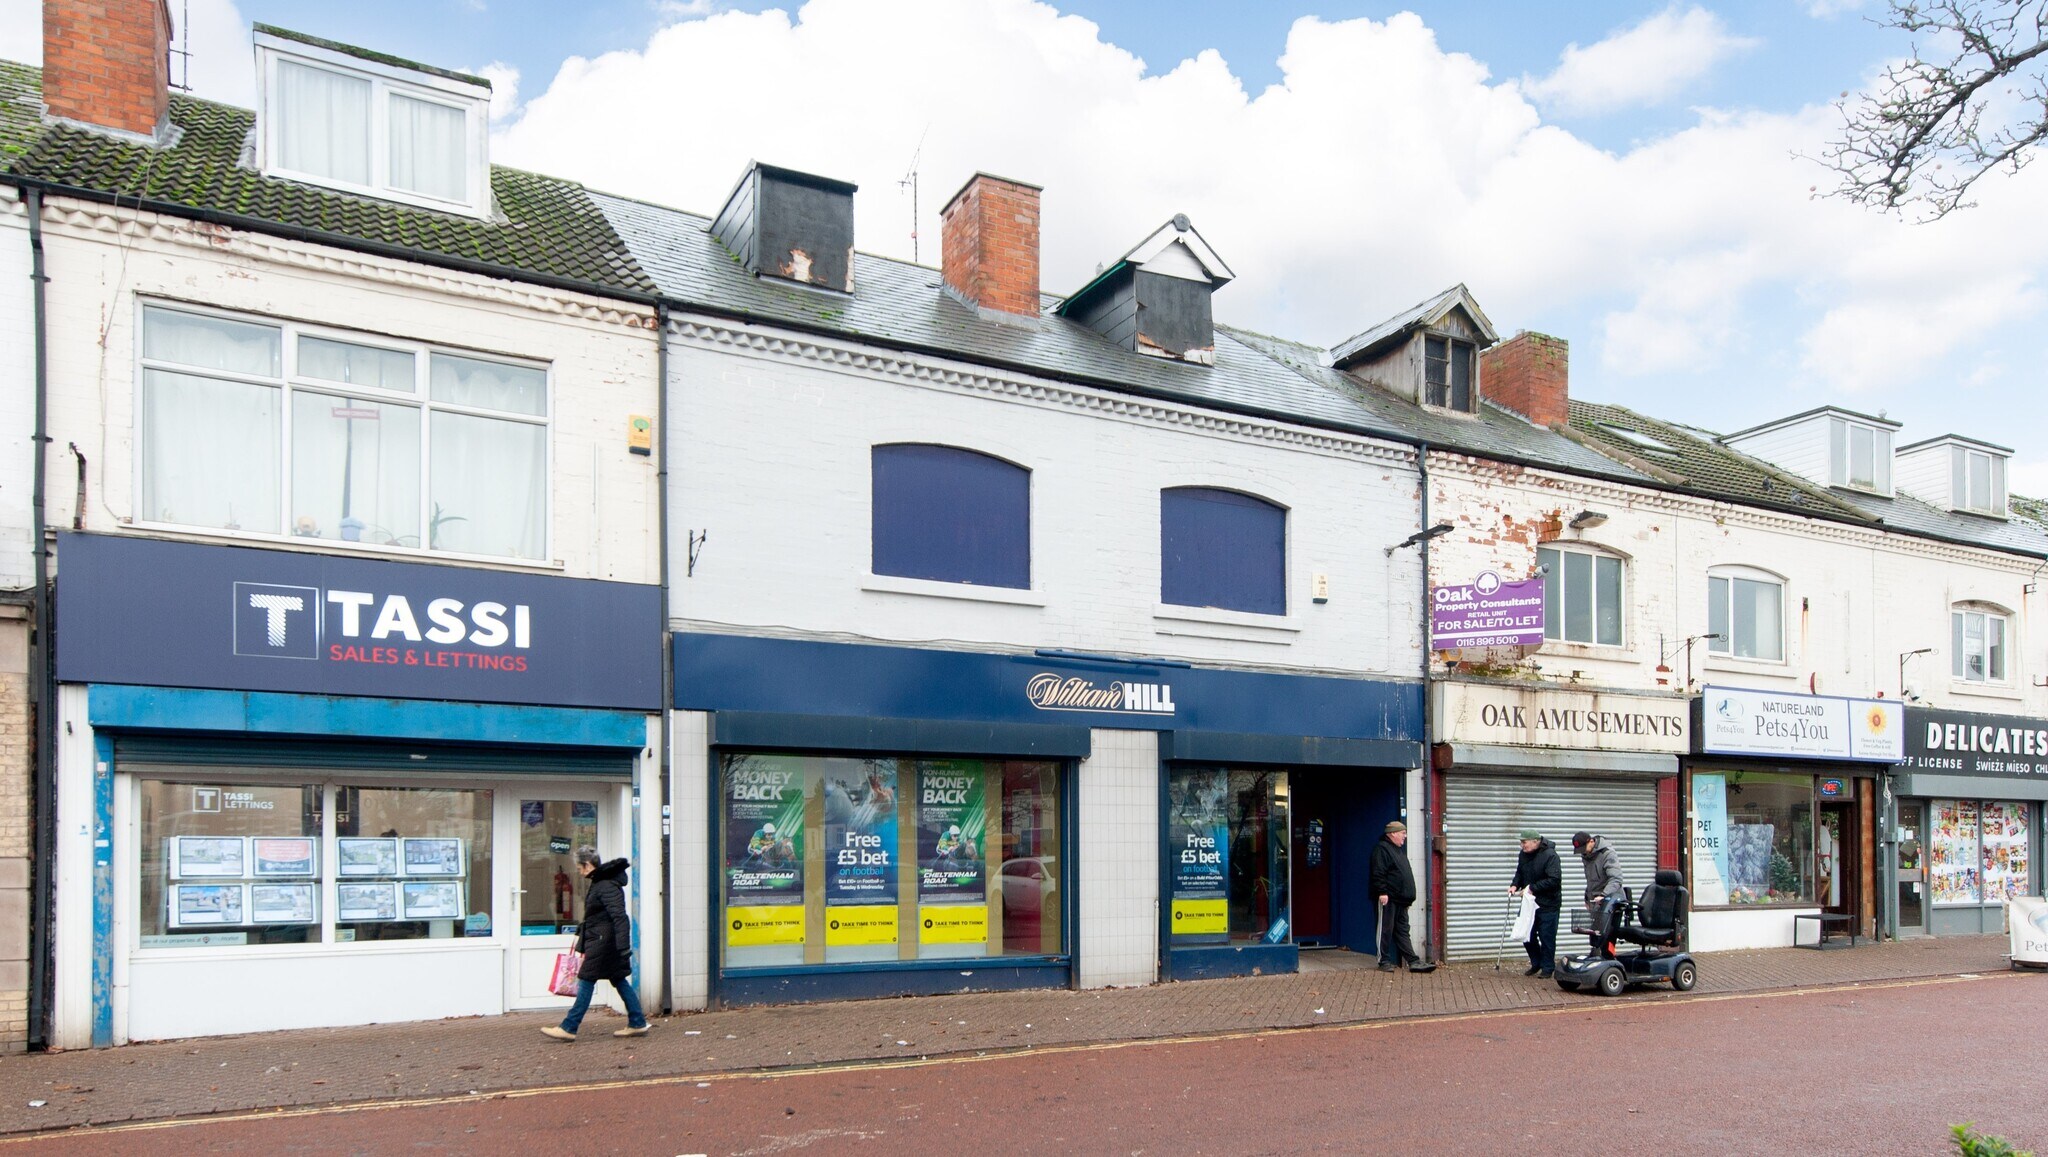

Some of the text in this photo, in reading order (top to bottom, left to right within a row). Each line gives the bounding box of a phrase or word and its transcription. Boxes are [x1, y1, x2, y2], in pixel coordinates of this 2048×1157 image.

[1435, 586, 1474, 602] Oak
[1435, 597, 1542, 612] Property Consultants
[249, 593, 304, 648] T
[327, 590, 531, 649] TASSI
[1437, 615, 1539, 630] FOR SALE/TO LET
[1456, 638, 1476, 647] 0115
[1496, 635, 1519, 644] 5010
[330, 644, 528, 672] SALES & LETTINGS
[1026, 672, 1175, 712] William HILL
[1762, 701, 1824, 717] NATURELAND
[1481, 704, 1683, 737] OAK AMUSEMENTS
[1716, 724, 1745, 735] Pets4You
[1755, 715, 1830, 742] Pets4You
[1926, 722, 2048, 756] DELICATES
[1895, 755, 1914, 767] FF
[1918, 758, 1963, 769] LICENSE
[733, 771, 793, 784] MONEY
[923, 776, 975, 789] MONEY
[223, 793, 254, 801] TASSI
[733, 785, 784, 800] BACK
[923, 790, 967, 804] BACK
[224, 801, 274, 810] LETTINGS
[312, 813, 349, 823] TSI
[1697, 820, 1712, 831] PET
[550, 842, 570, 850] open
[846, 831, 881, 847] Free
[1187, 834, 1215, 848] Free
[1693, 837, 1719, 848] STORE
[837, 849, 889, 865] £5 bet
[1181, 849, 1221, 863] £5 bet
[853, 867, 884, 875] football
[1193, 865, 1218, 873] football
